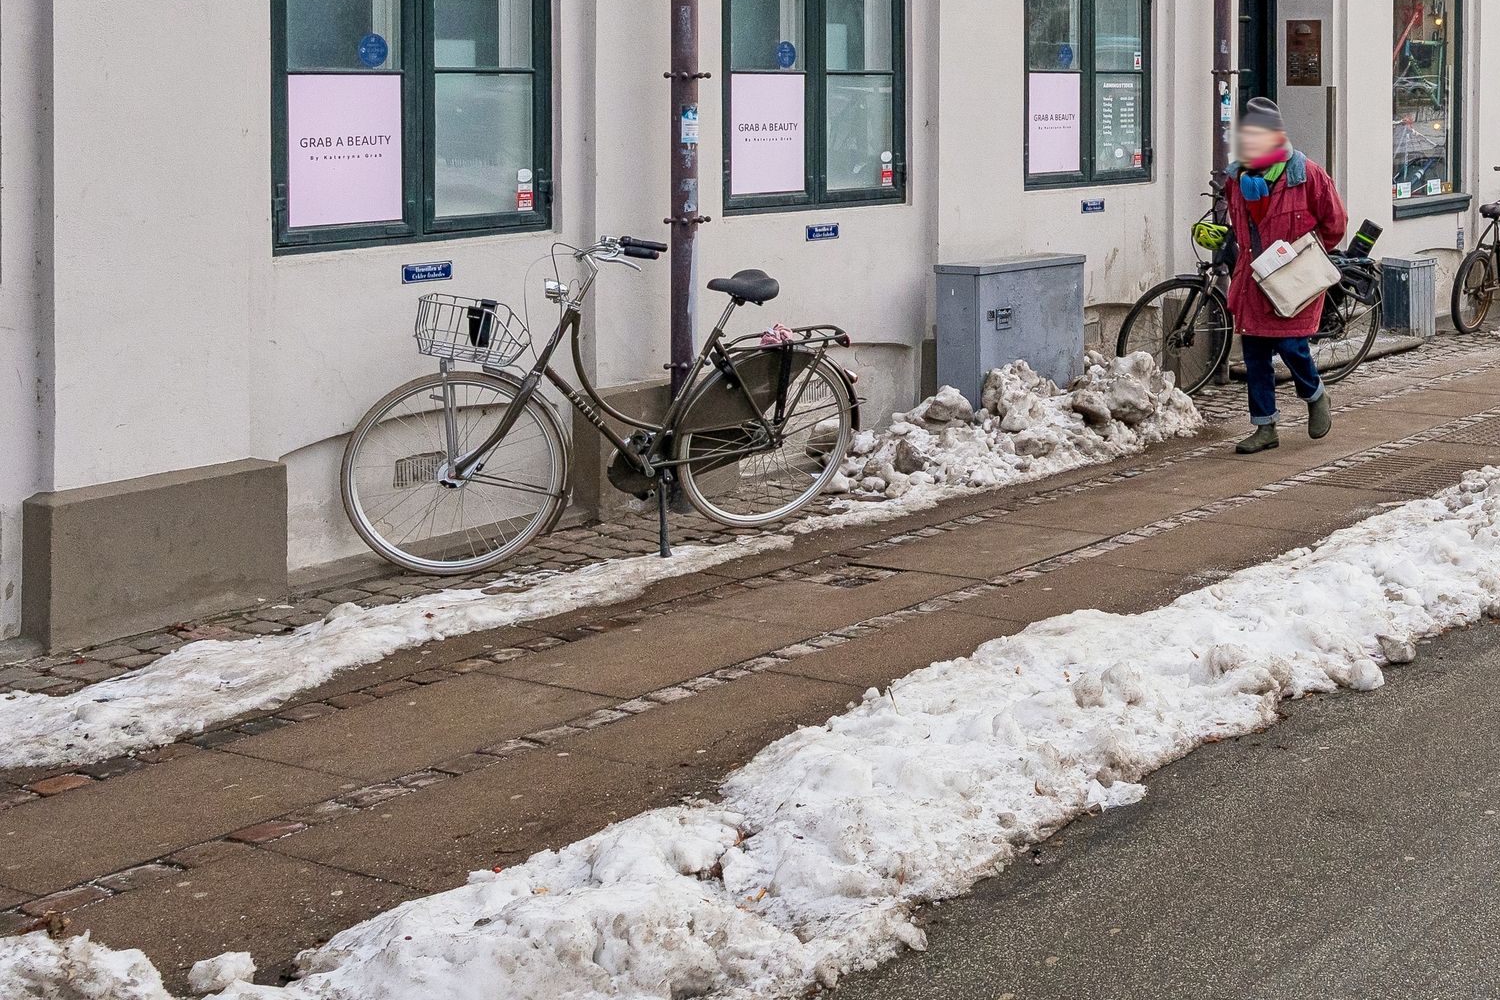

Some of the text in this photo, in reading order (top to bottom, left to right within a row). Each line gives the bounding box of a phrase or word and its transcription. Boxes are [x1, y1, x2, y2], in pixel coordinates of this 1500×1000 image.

[738, 123, 798, 131] GRAB A BEAUTY
[300, 135, 391, 148] GRAB A BEAUTY
